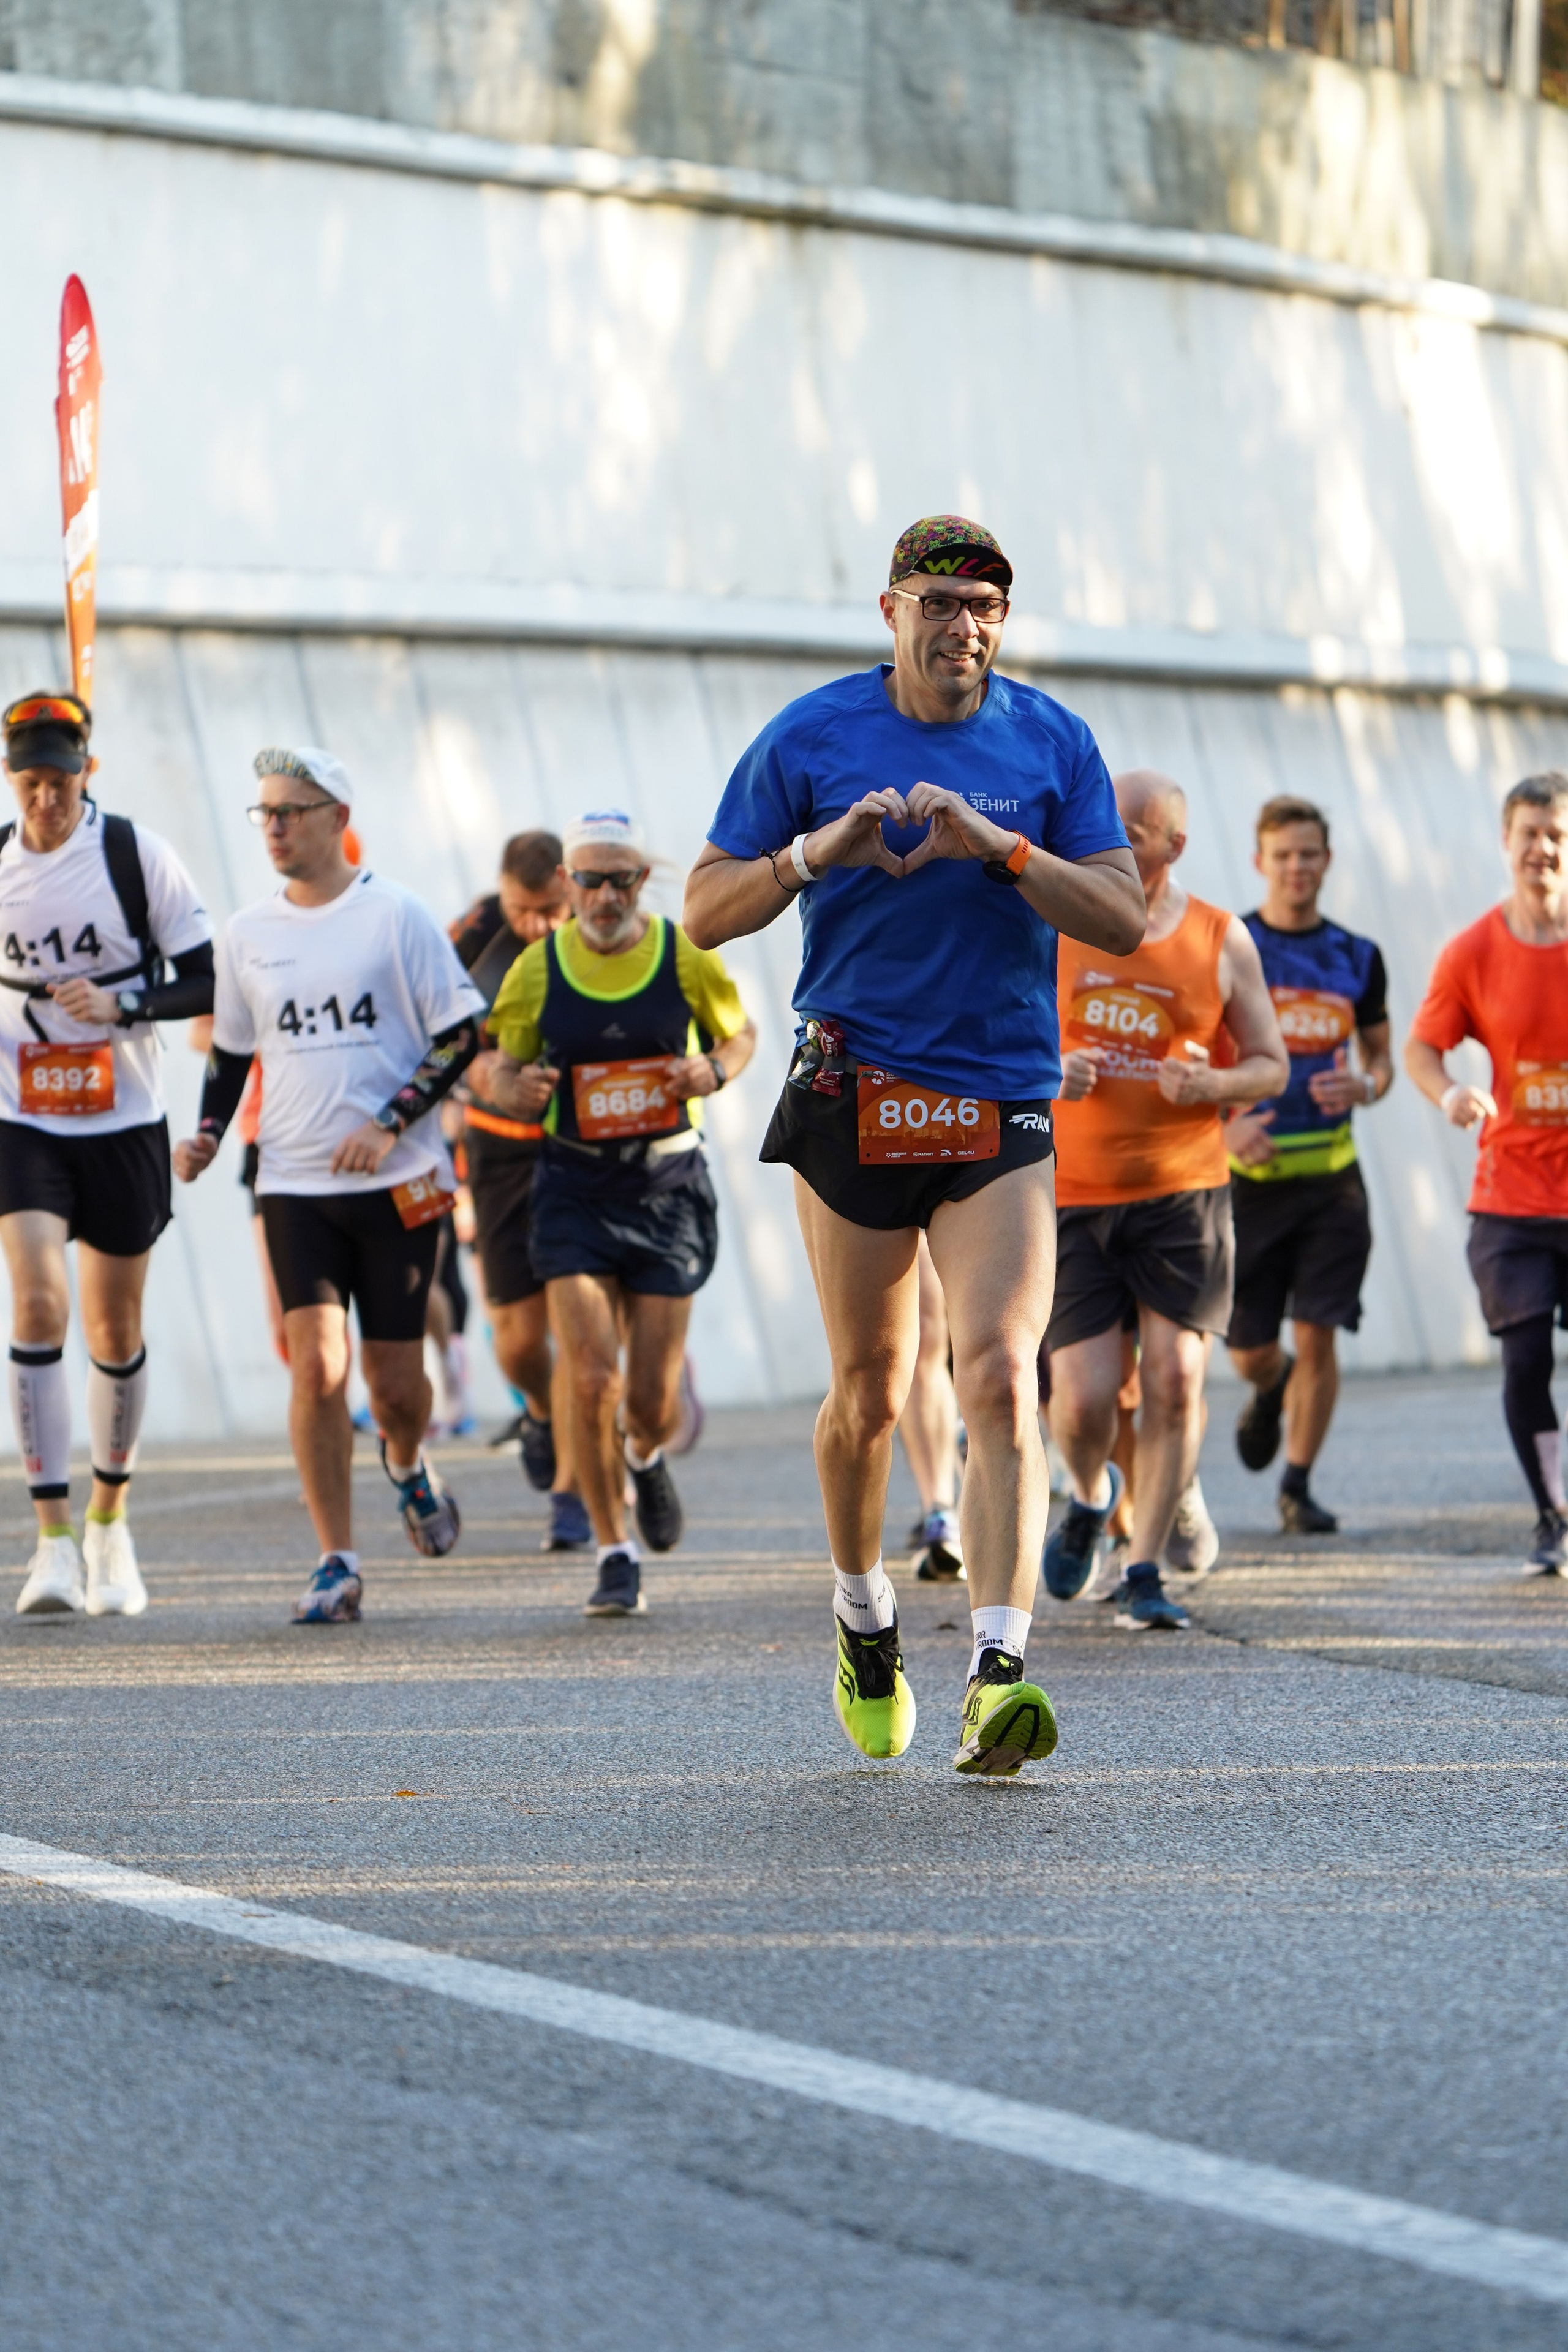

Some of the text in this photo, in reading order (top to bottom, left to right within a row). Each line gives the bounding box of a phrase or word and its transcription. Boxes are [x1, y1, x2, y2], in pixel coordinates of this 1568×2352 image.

[970, 798, 1020, 812] ЗЕНИТ
[4, 921, 102, 968] 4:14
[277, 990, 377, 1036] 4:14
[1085, 998, 1159, 1039] 8104
[32, 1065, 101, 1091] 8392
[589, 1084, 666, 1118] 8684
[879, 1098, 979, 1129] 8046
